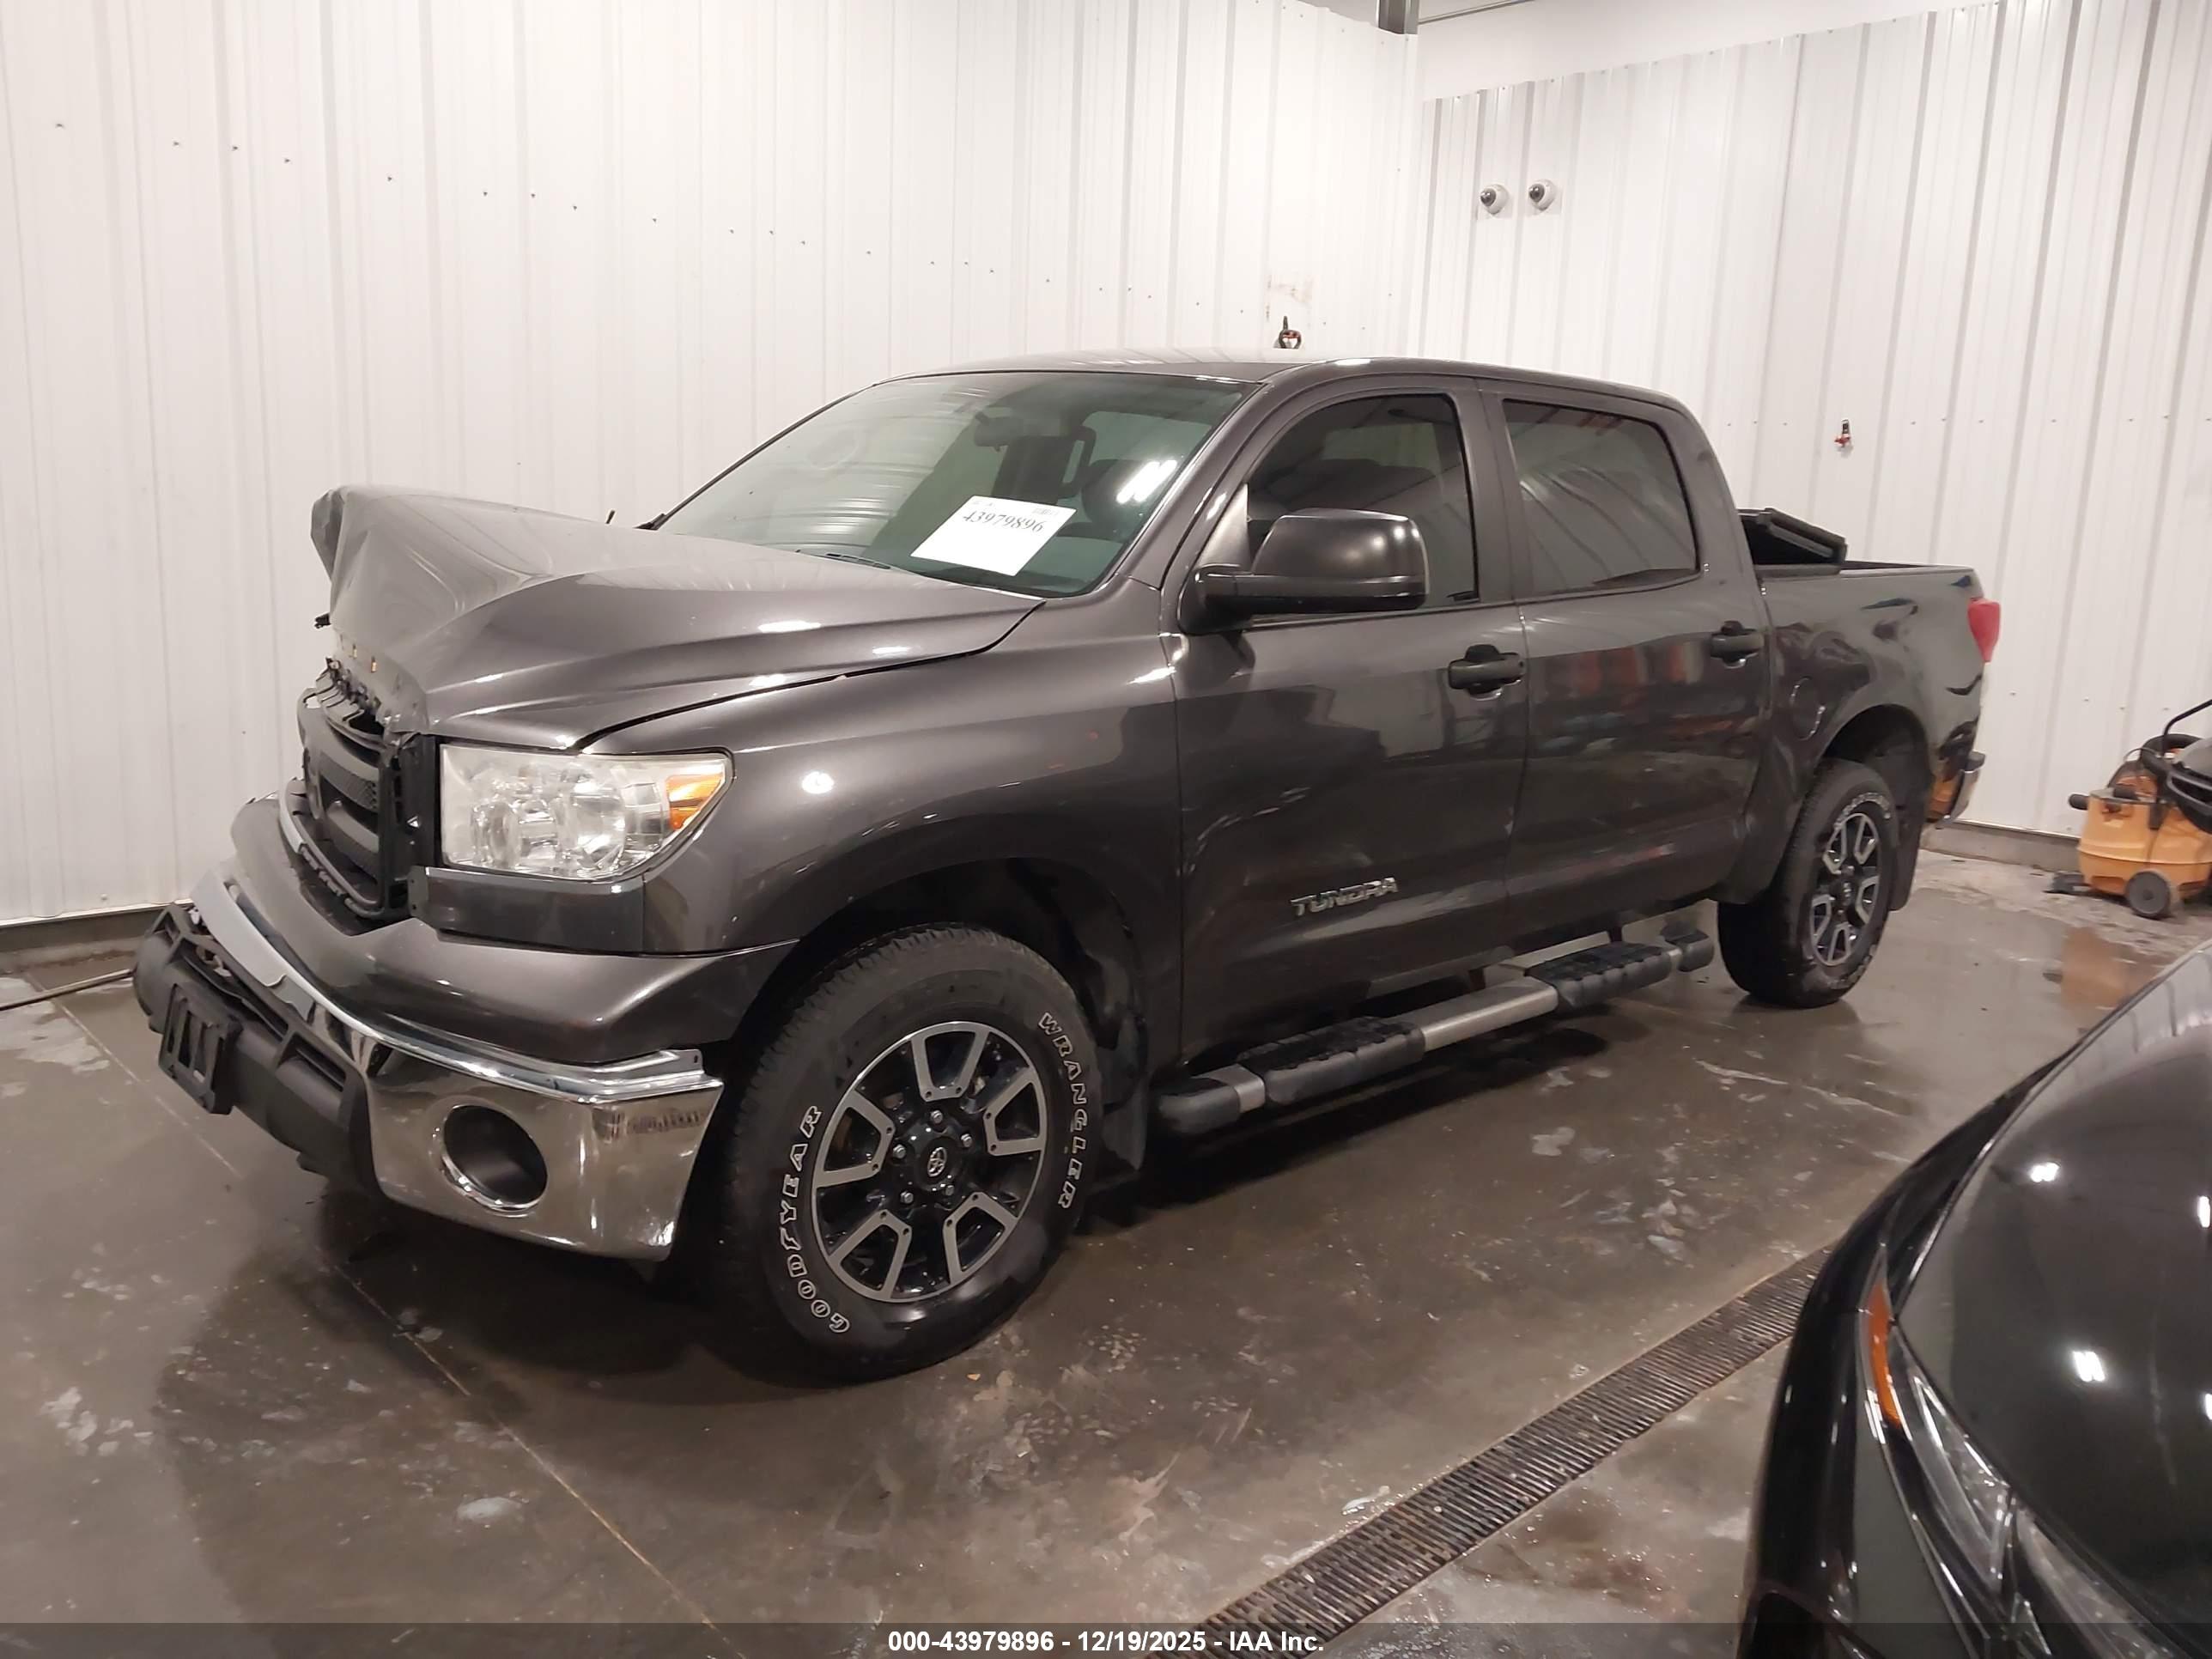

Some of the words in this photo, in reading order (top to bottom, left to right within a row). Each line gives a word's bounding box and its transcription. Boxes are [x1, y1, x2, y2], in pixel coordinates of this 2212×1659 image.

[963, 510, 1045, 532] 43979896
[1290, 877, 1399, 916] TUNDRA
[1038, 1012, 1088, 1209] WRANGLER
[780, 1105, 850, 1334] GOODYEAR
